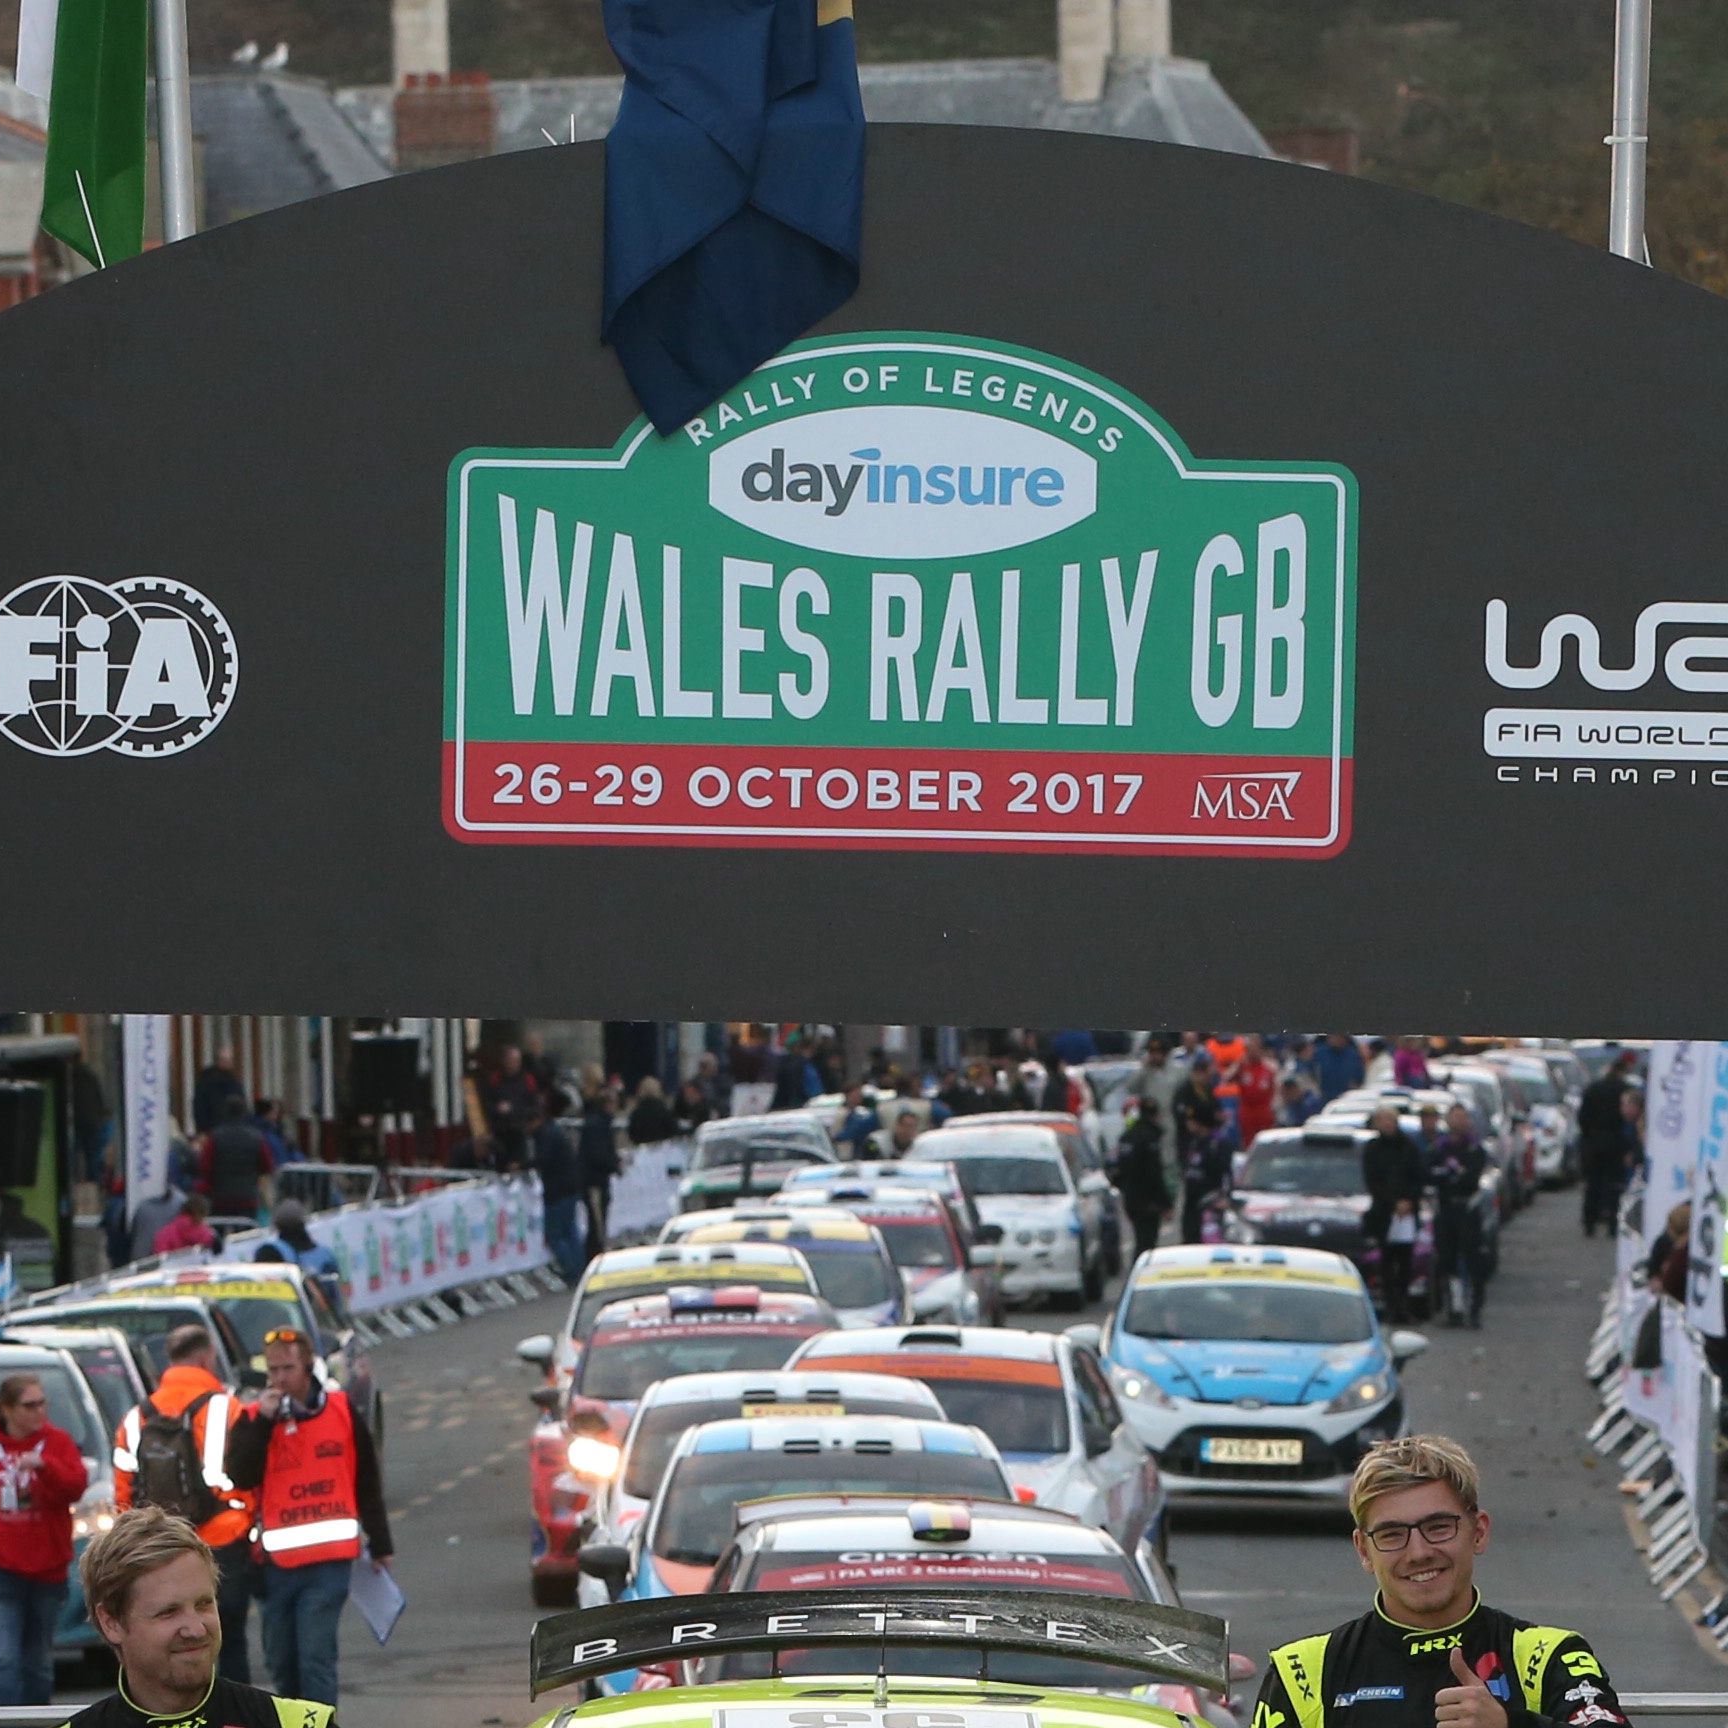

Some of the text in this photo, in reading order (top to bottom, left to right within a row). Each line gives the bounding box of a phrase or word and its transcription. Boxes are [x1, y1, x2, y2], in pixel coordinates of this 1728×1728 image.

[685, 364, 1126, 454] RALLY OF LEGENDS
[741, 447, 1065, 518] dayinsure
[497, 493, 1308, 730] WALES RALLY GB
[1498, 722, 1561, 743] FIA
[492, 764, 1301, 824] 26-29 OCTOBER 2017 MSA
[279, 1502, 351, 1525] OFFICIAL
[289, 1479, 336, 1500] CHIEF
[573, 1612, 1189, 1665] BRETTEX
[1410, 1632, 1463, 1656] HRX
[1286, 1654, 1315, 1702] HRX
[1525, 1639, 1549, 1690] HRX
